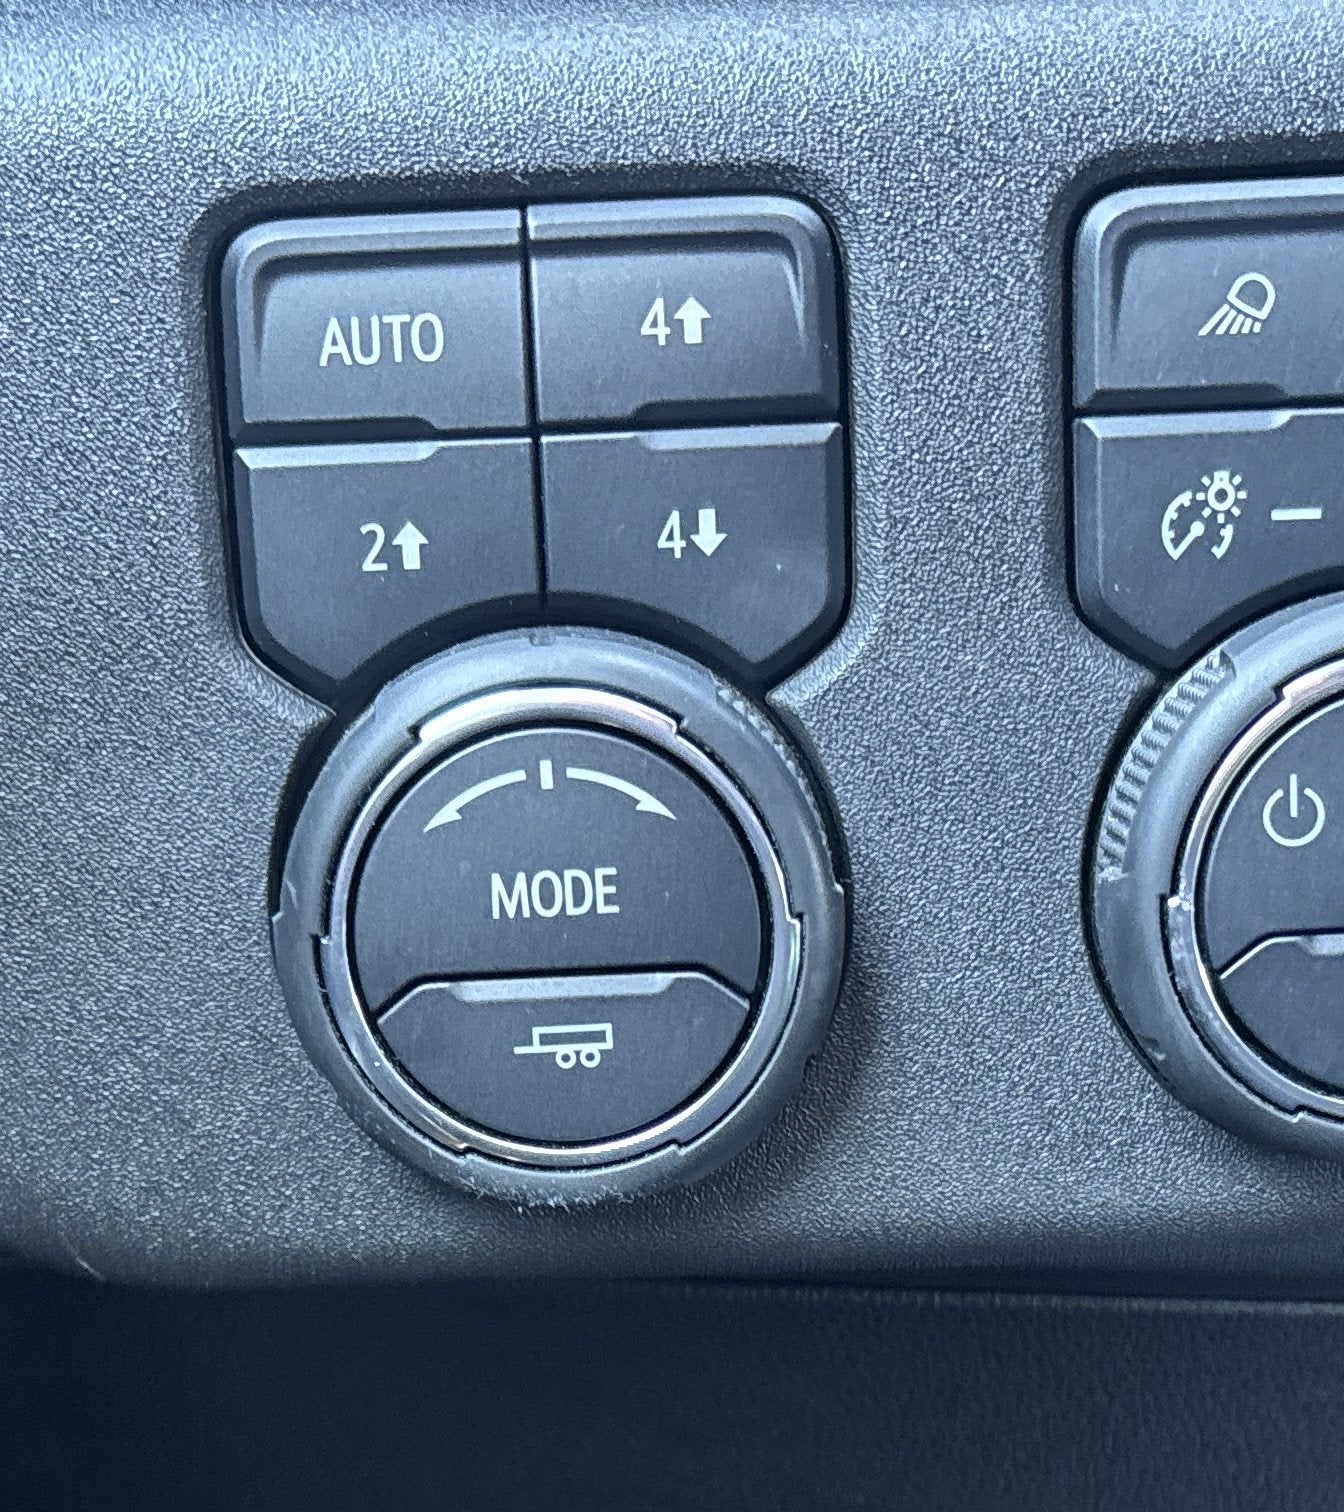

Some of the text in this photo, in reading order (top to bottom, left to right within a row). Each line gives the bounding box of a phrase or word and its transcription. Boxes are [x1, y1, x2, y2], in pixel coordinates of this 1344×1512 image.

[318, 312, 445, 367] AUTO
[640, 297, 671, 347] 4
[359, 522, 389, 573] 2
[656, 509, 687, 559] 4
[490, 866, 621, 920] MODE
